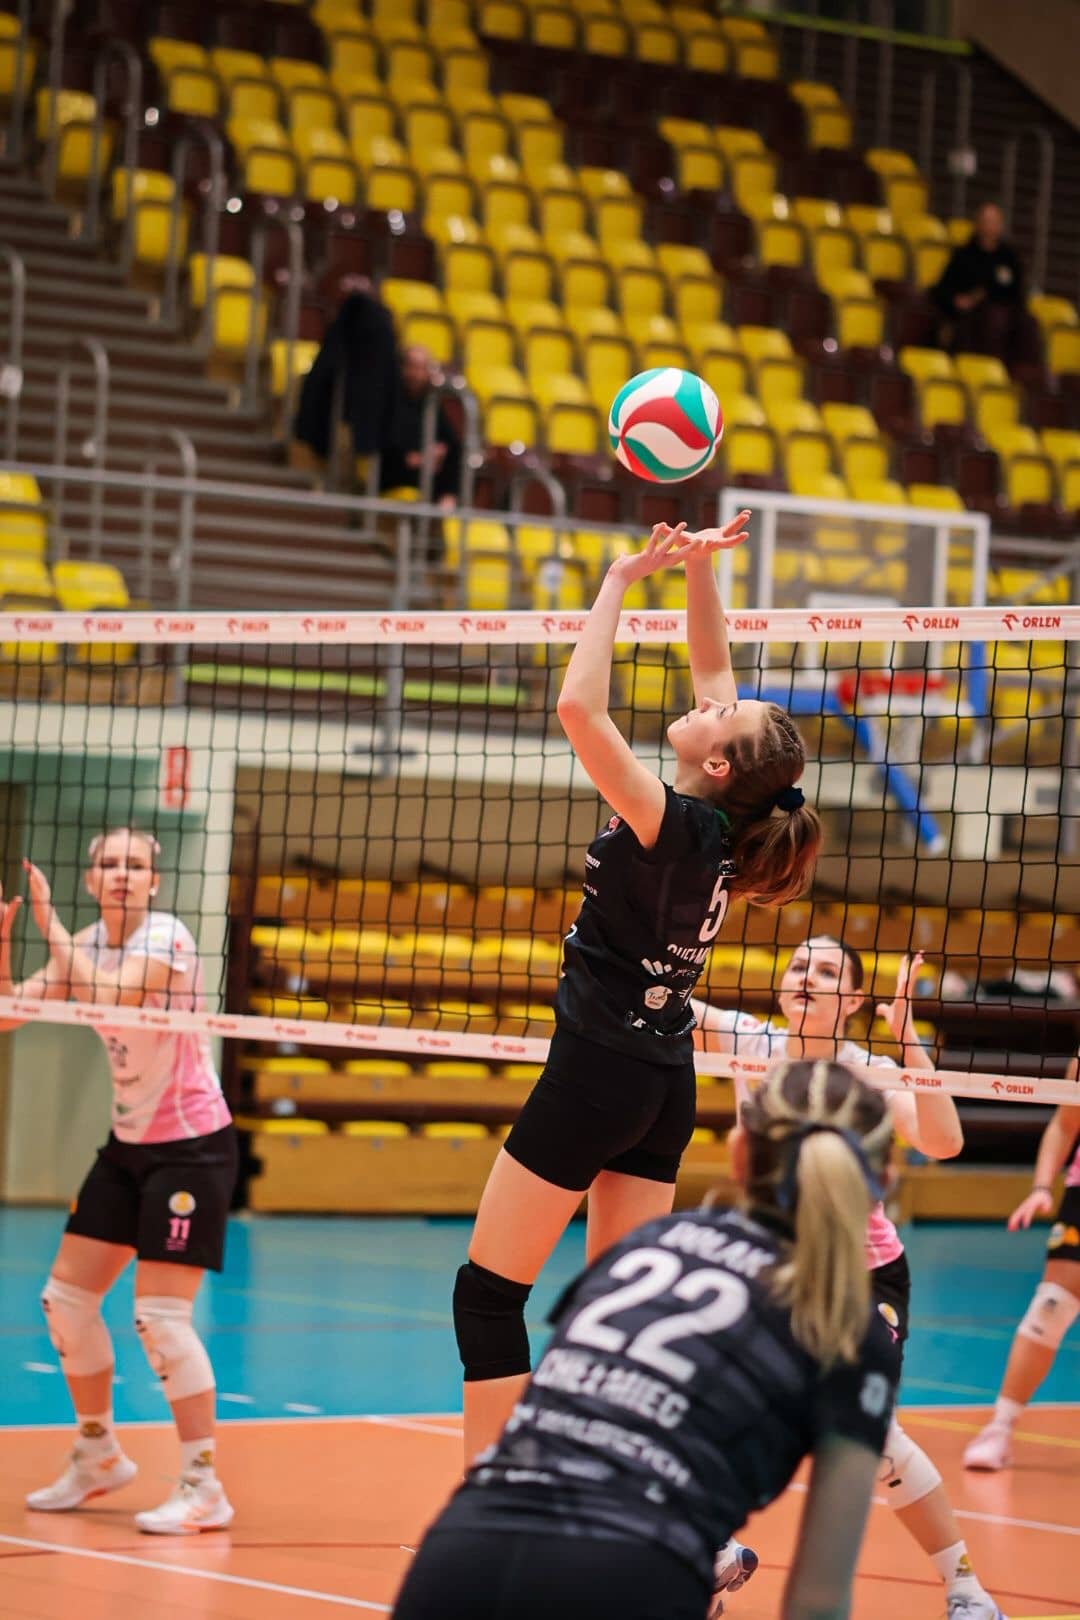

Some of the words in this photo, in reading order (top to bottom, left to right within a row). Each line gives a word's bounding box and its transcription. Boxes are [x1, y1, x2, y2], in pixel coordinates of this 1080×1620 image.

[559, 619, 584, 631] ORLE
[644, 618, 678, 631] ORLEN
[735, 618, 768, 631] ORLEN
[827, 617, 862, 630] ORLEN
[923, 617, 959, 629] ORLEN
[1022, 616, 1061, 628] ORLEN
[915, 1077, 942, 1088] ORLEN
[1005, 1083, 1034, 1095] ORLEN
[168, 1218, 191, 1240] 11
[565, 1247, 750, 1384] 22
